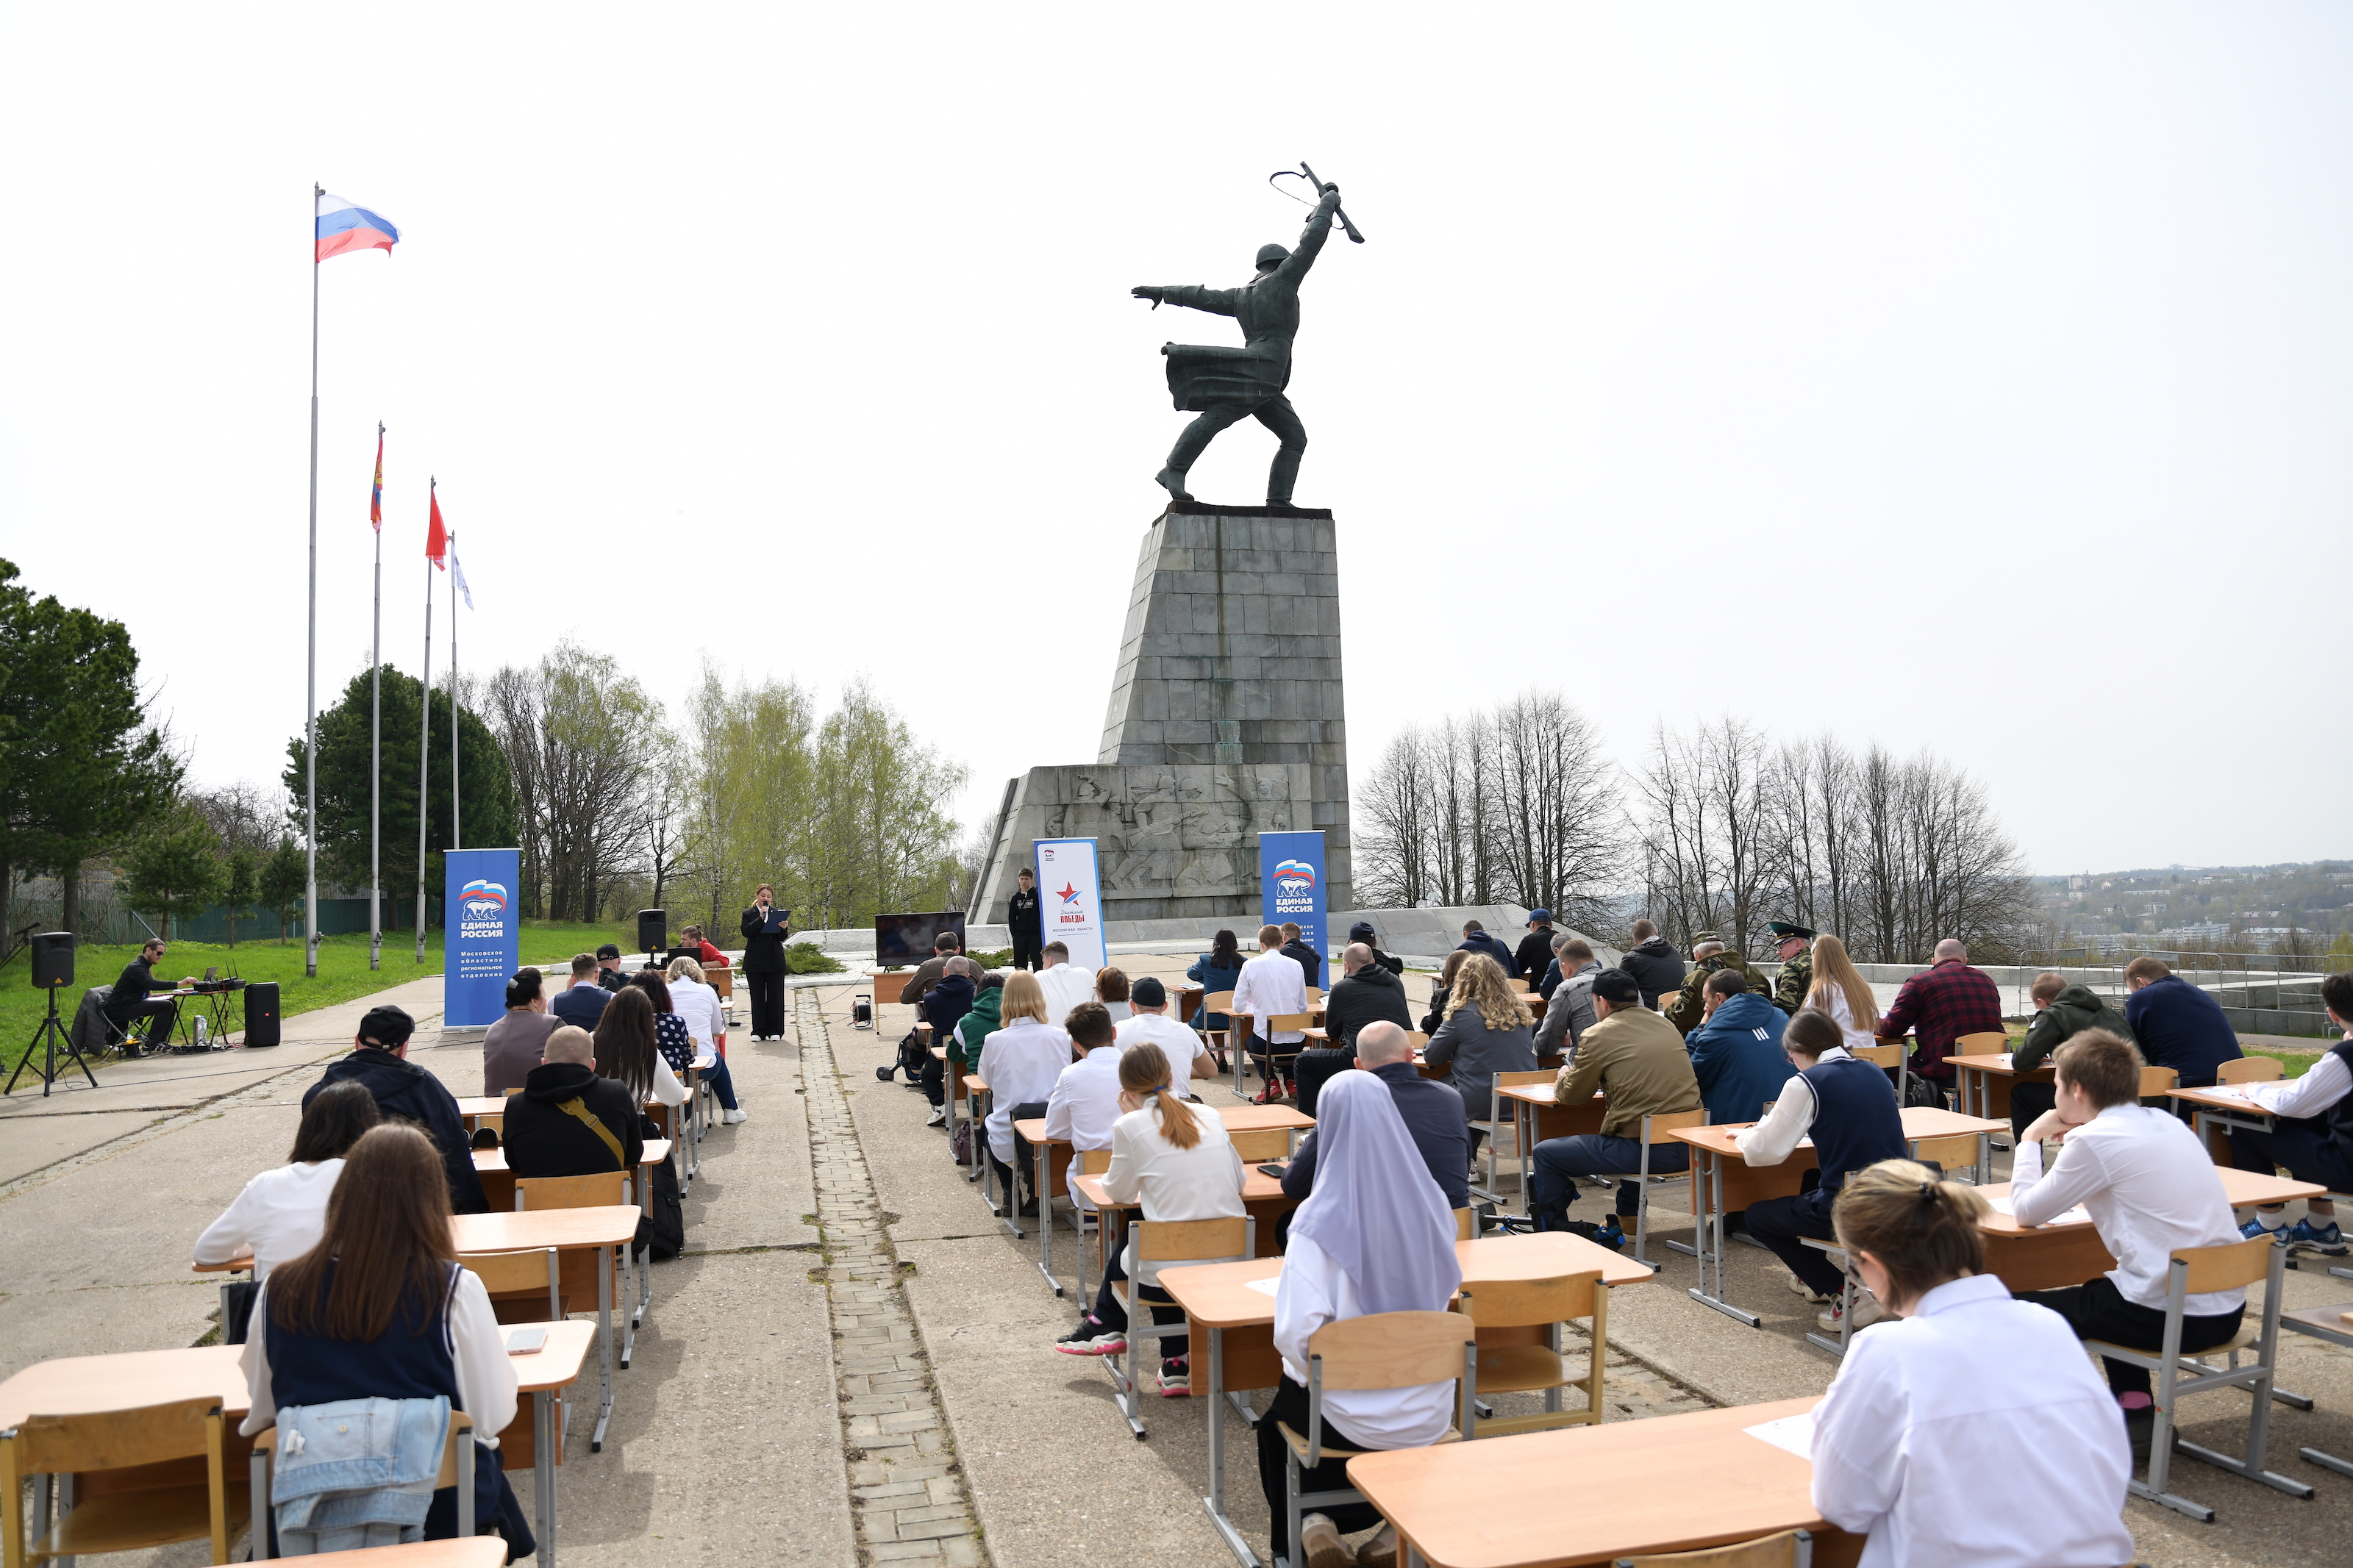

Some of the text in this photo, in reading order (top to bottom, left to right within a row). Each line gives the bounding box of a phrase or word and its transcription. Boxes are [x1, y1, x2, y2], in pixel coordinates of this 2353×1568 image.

[1276, 898, 1313, 906] ЕДИНАЯ
[1060, 914, 1085, 923] ПОБЕДЫ
[461, 921, 503, 930] ЕДИНАЯ
[461, 929, 503, 938] РОССИЯ
